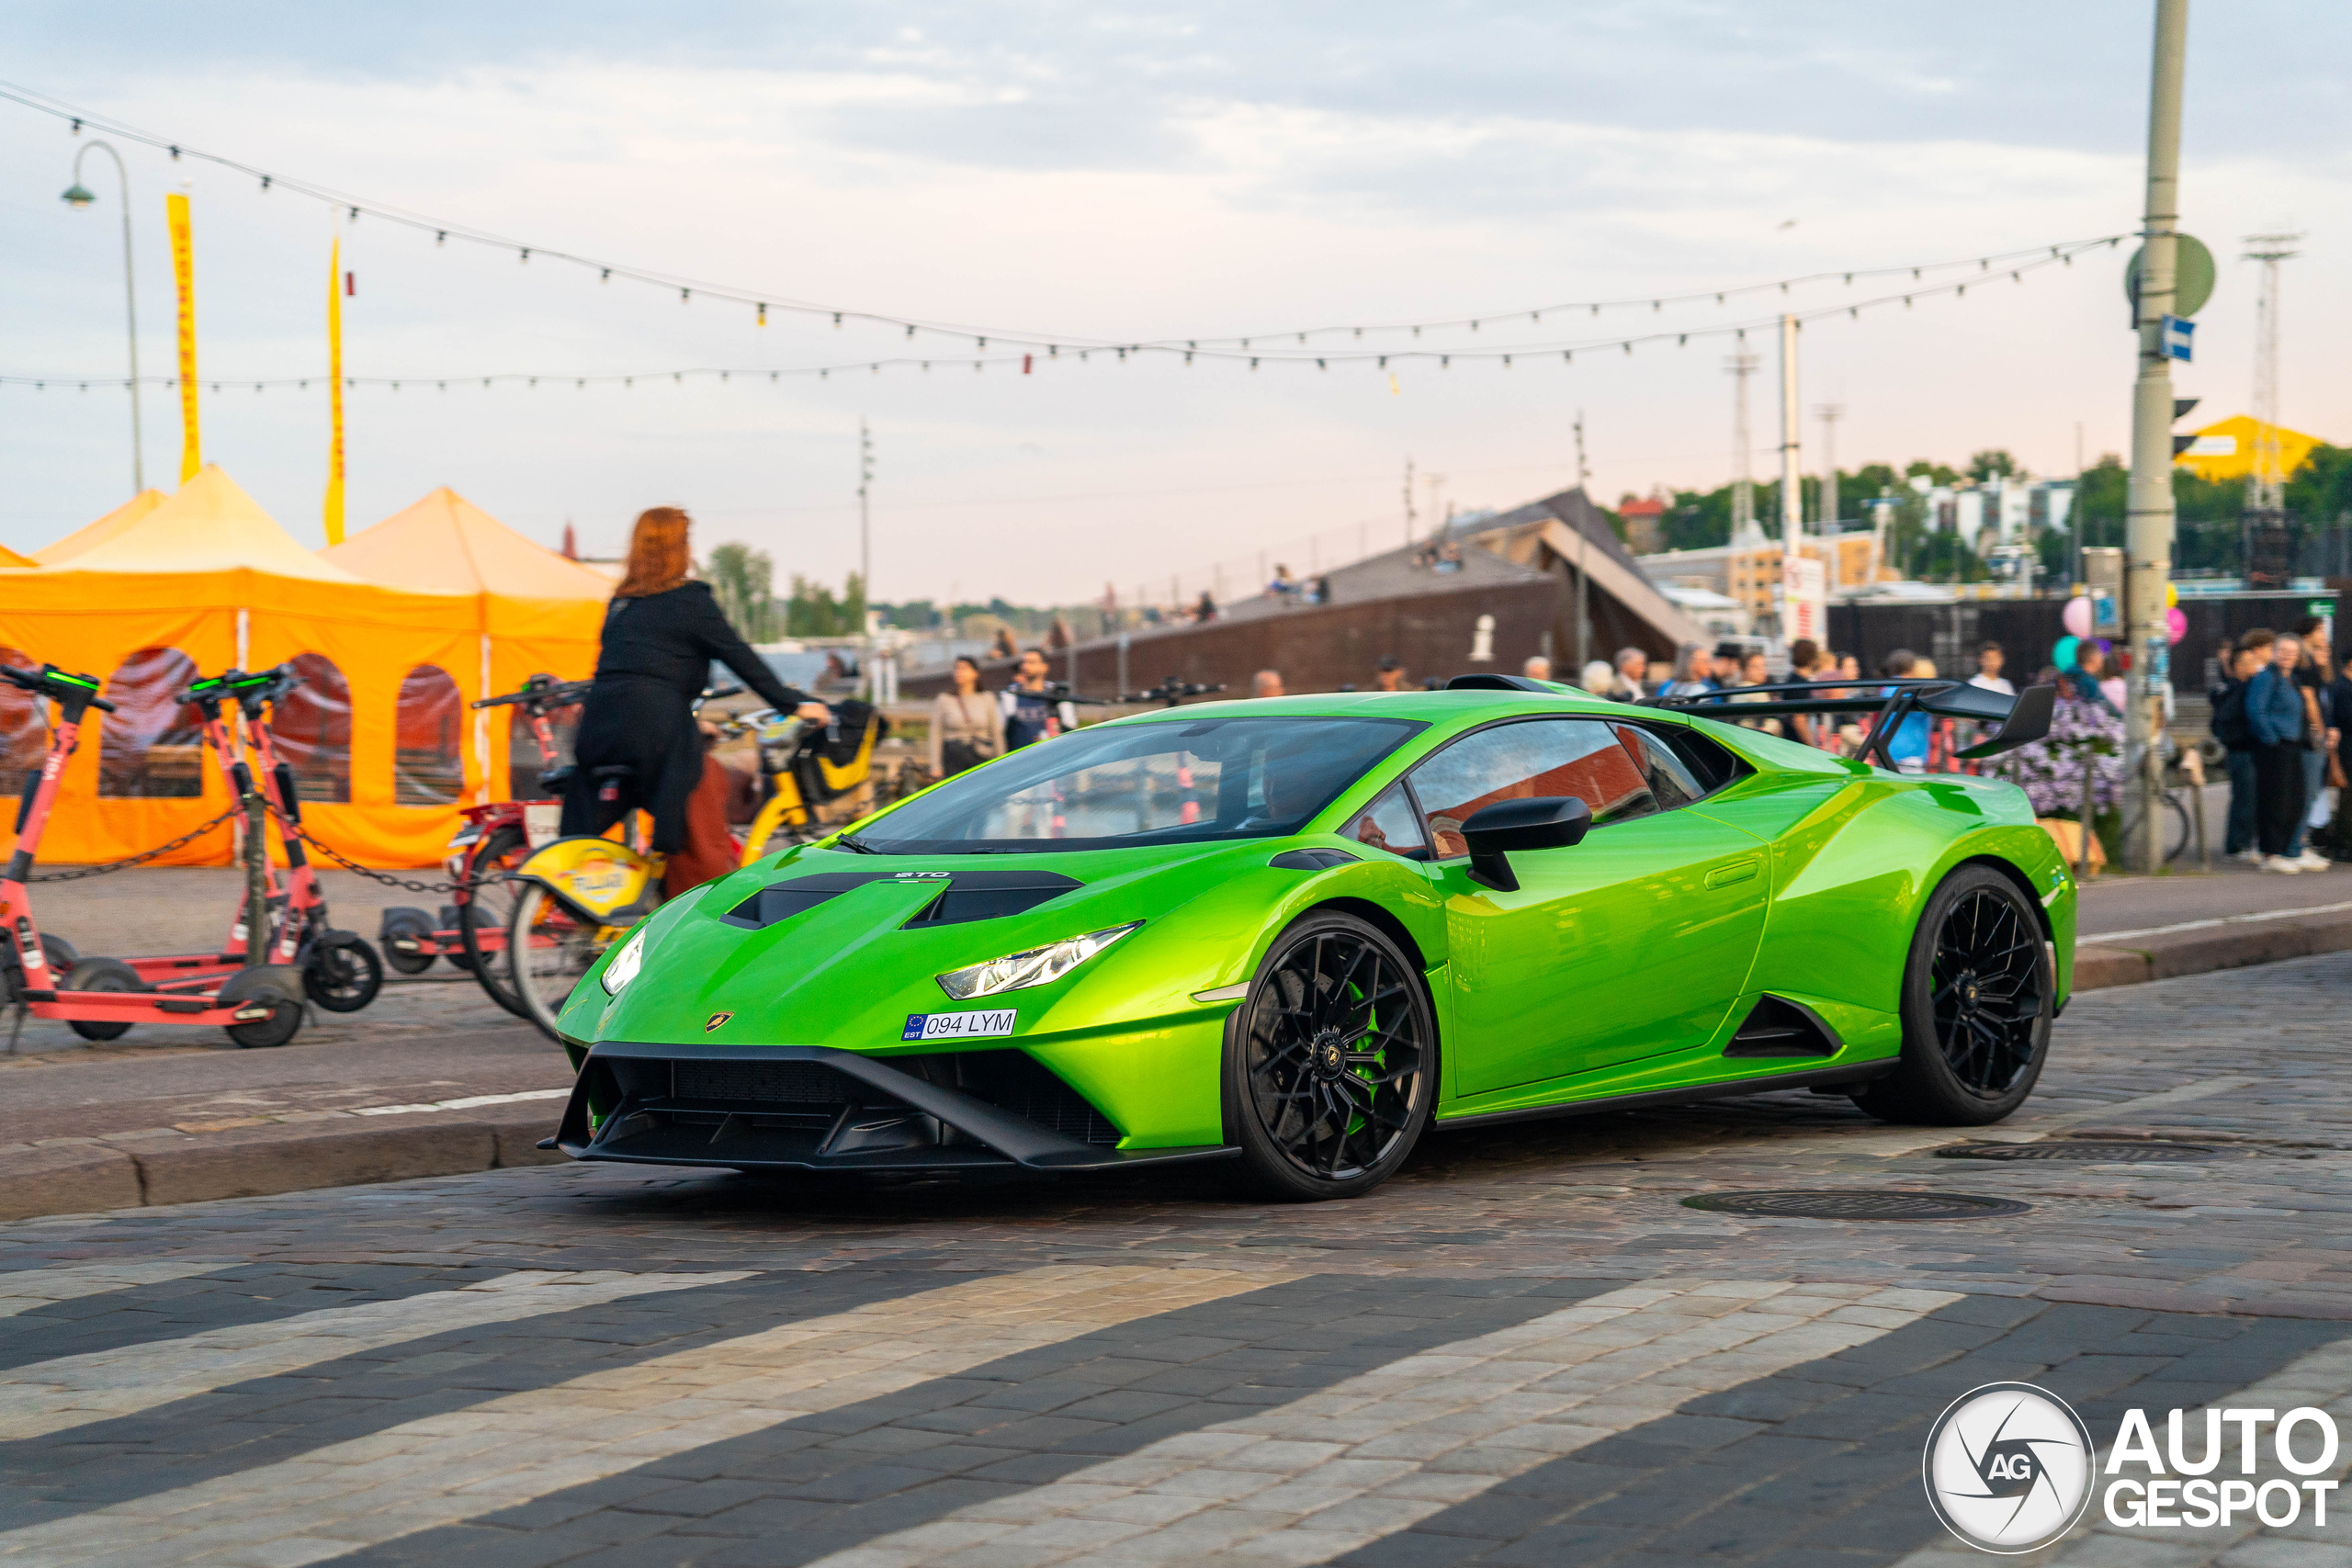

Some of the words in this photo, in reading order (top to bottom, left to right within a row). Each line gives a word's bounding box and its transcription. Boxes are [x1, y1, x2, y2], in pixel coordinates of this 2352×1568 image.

[926, 1016, 963, 1035] 094
[967, 1012, 1013, 1032] LYM
[904, 1031, 922, 1039] EST
